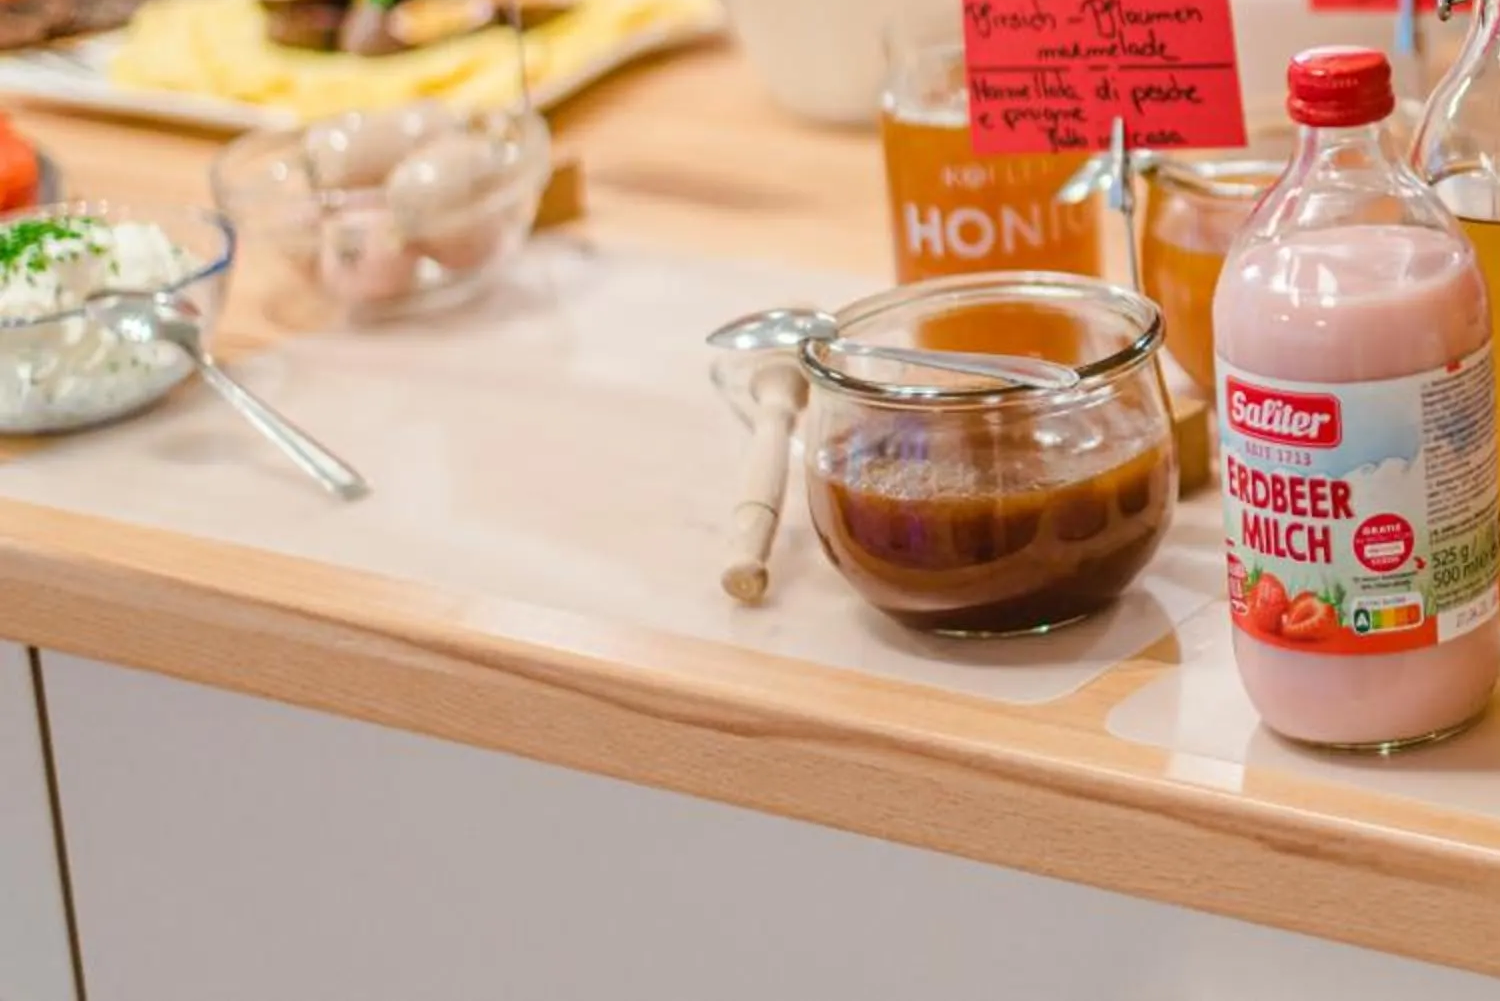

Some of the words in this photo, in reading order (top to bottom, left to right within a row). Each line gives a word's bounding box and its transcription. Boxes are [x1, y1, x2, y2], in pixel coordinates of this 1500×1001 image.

[1096, 76, 1121, 101] di
[1231, 390, 1332, 439] Saliter
[1227, 454, 1354, 520] ERDBEER
[1241, 509, 1333, 564] MILCH
[1432, 545, 1457, 570] 525
[1433, 565, 1461, 589] 500
